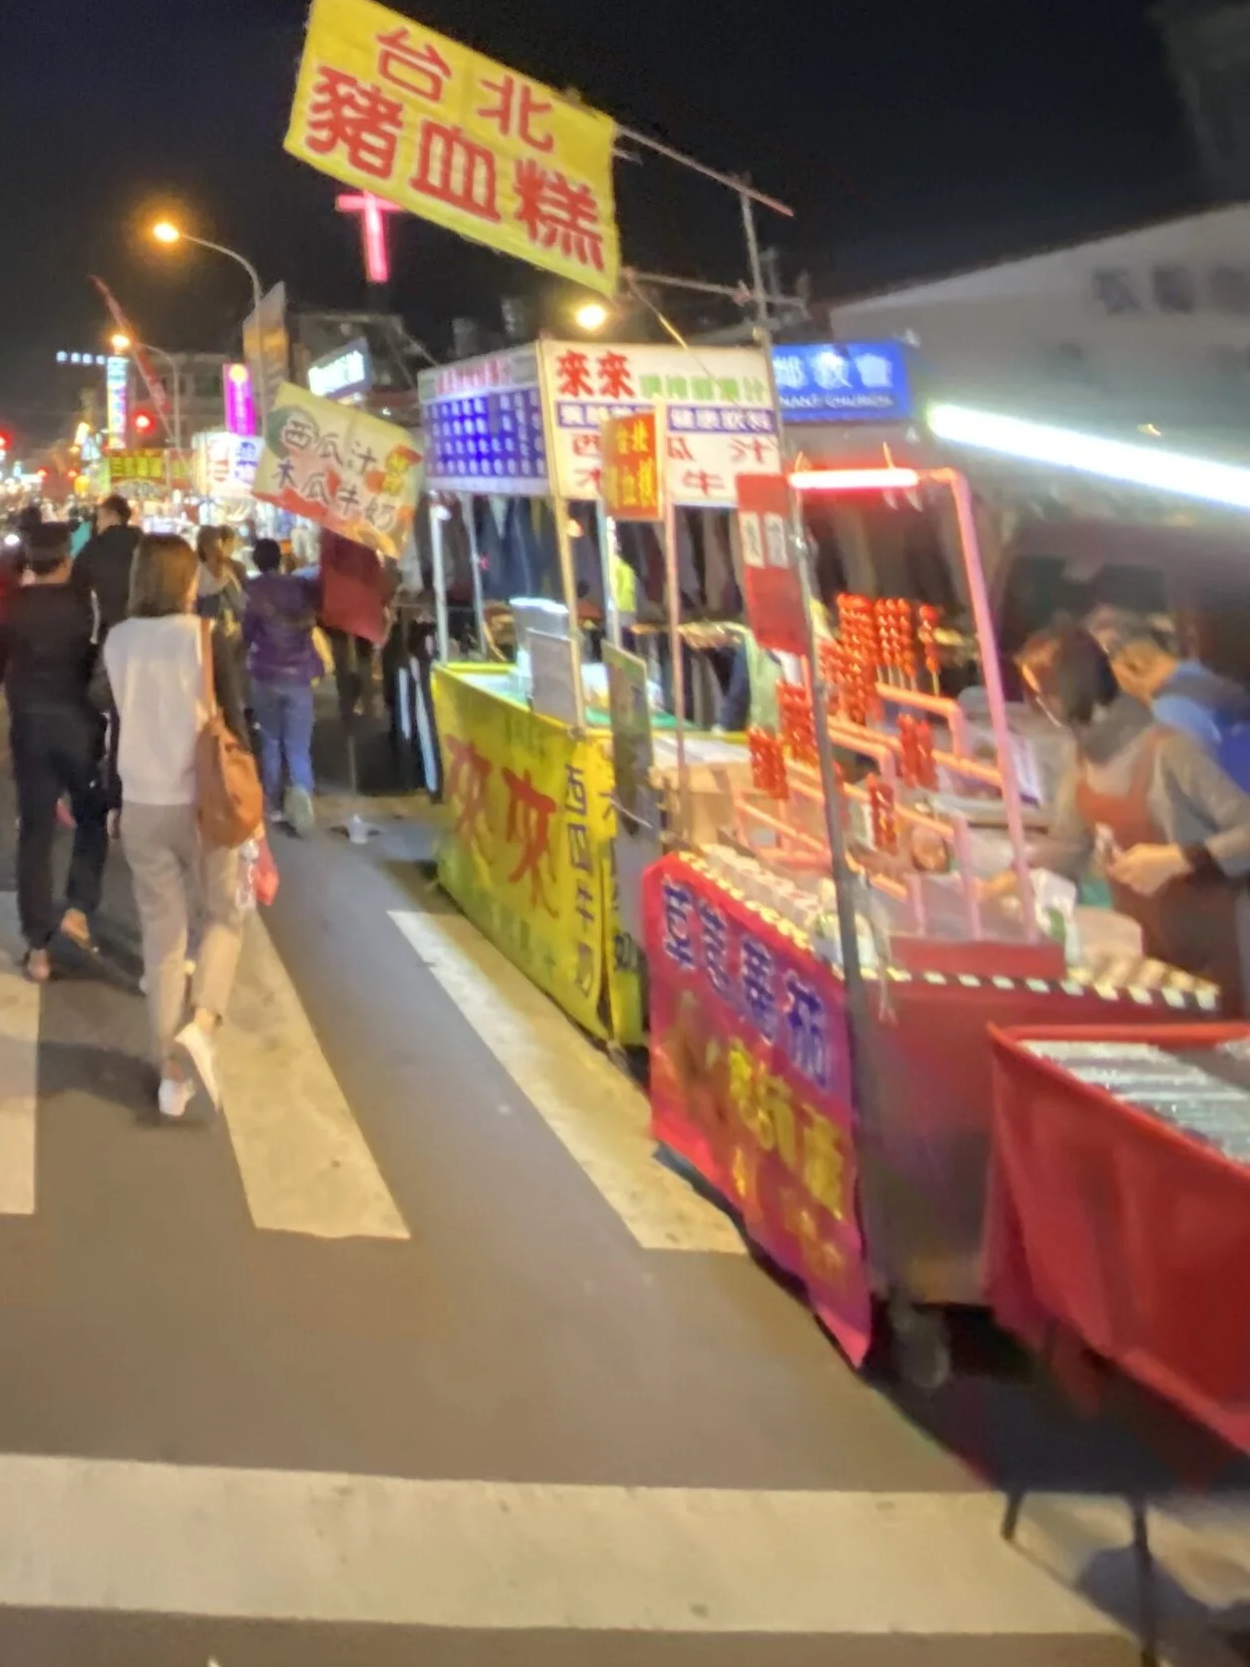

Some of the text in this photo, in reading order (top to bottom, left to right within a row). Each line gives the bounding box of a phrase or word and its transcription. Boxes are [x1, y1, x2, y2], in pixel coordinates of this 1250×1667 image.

[375, 26, 555, 154] 台北
[305, 65, 605, 272] 豬血糕
[556, 349, 635, 399] 來來
[280, 418, 378, 476] 西瓜汁
[271, 457, 398, 533] 木瓜牛奶
